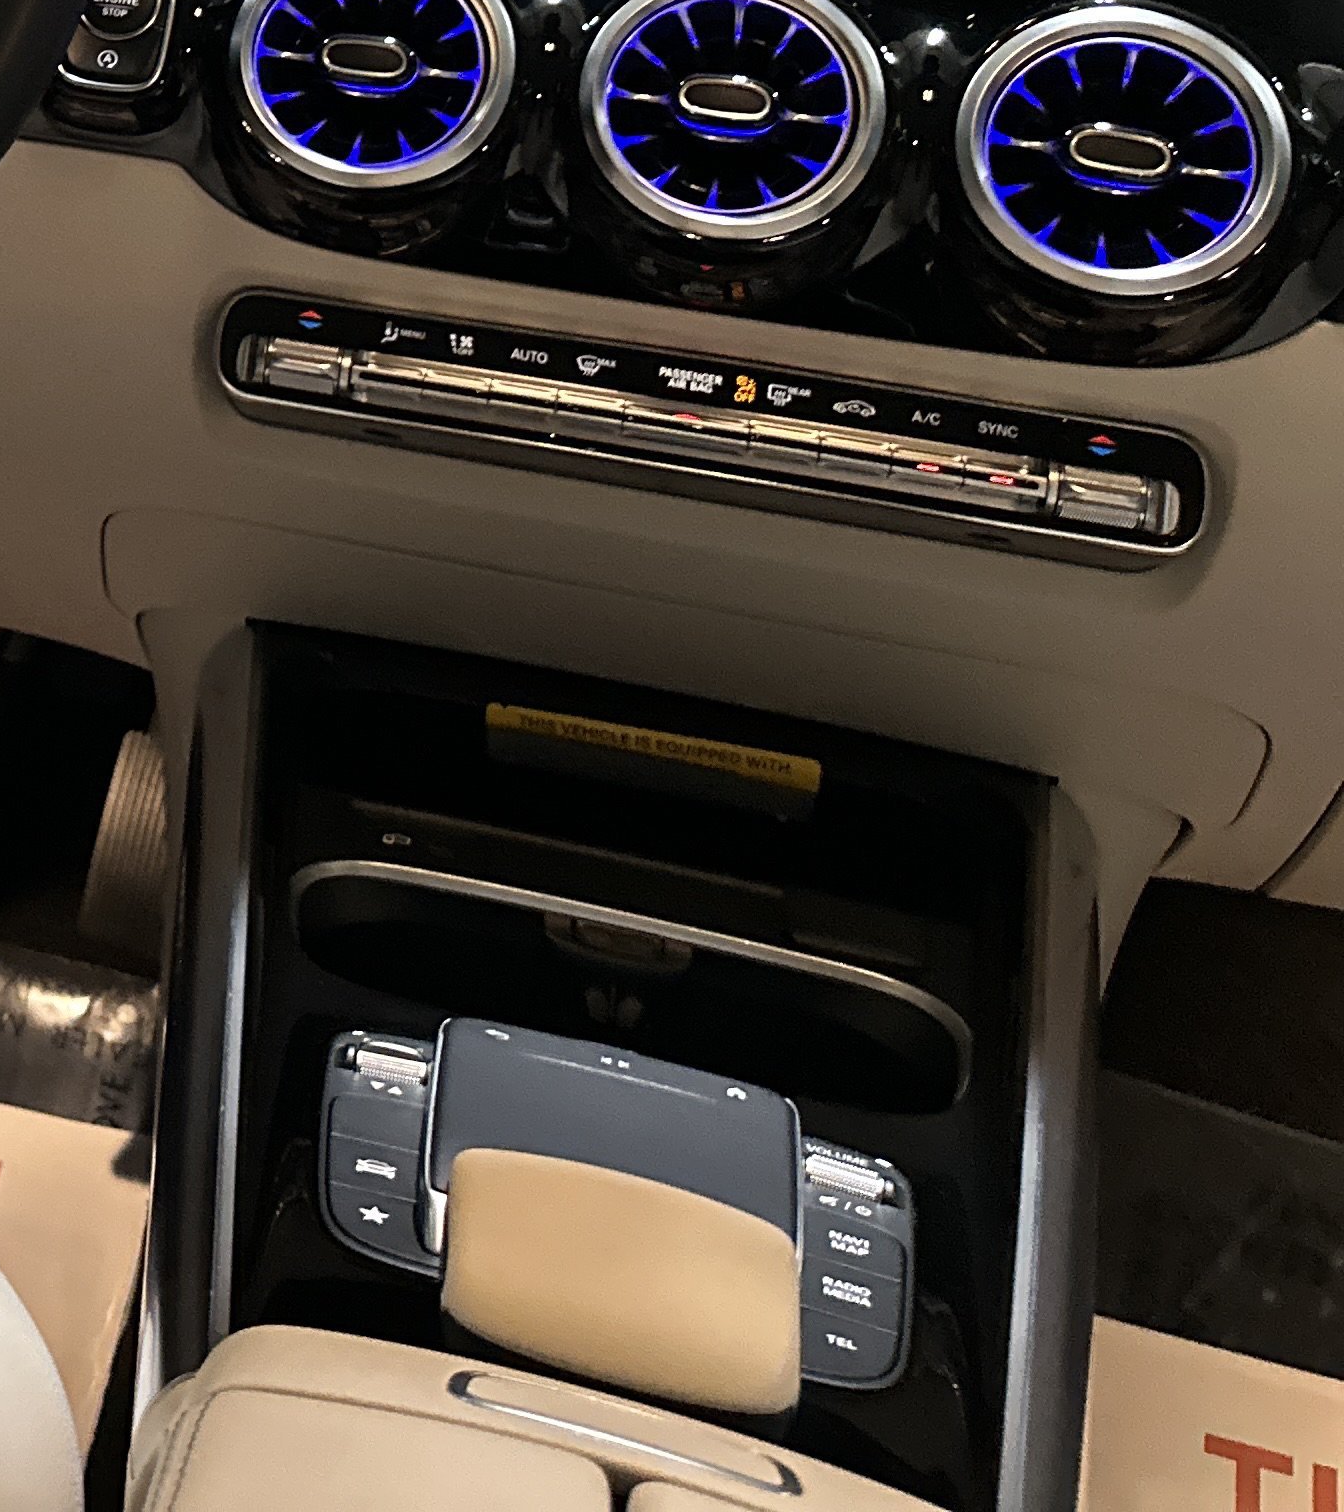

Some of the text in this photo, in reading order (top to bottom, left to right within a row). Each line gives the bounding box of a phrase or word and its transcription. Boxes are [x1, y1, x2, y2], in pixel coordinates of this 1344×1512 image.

[101, 7, 129, 18] STOP
[510, 347, 549, 365] AUTO
[658, 365, 724, 386] PASSENGER
[911, 409, 942, 427] A/C
[977, 420, 1019, 439] SYNC
[828, 1230, 870, 1248] NAVI
[831, 1240, 870, 1256] MAP
[822, 1276, 872, 1296] RADIO
[823, 1286, 872, 1308] MEDIA
[825, 1333, 858, 1351] TEL
